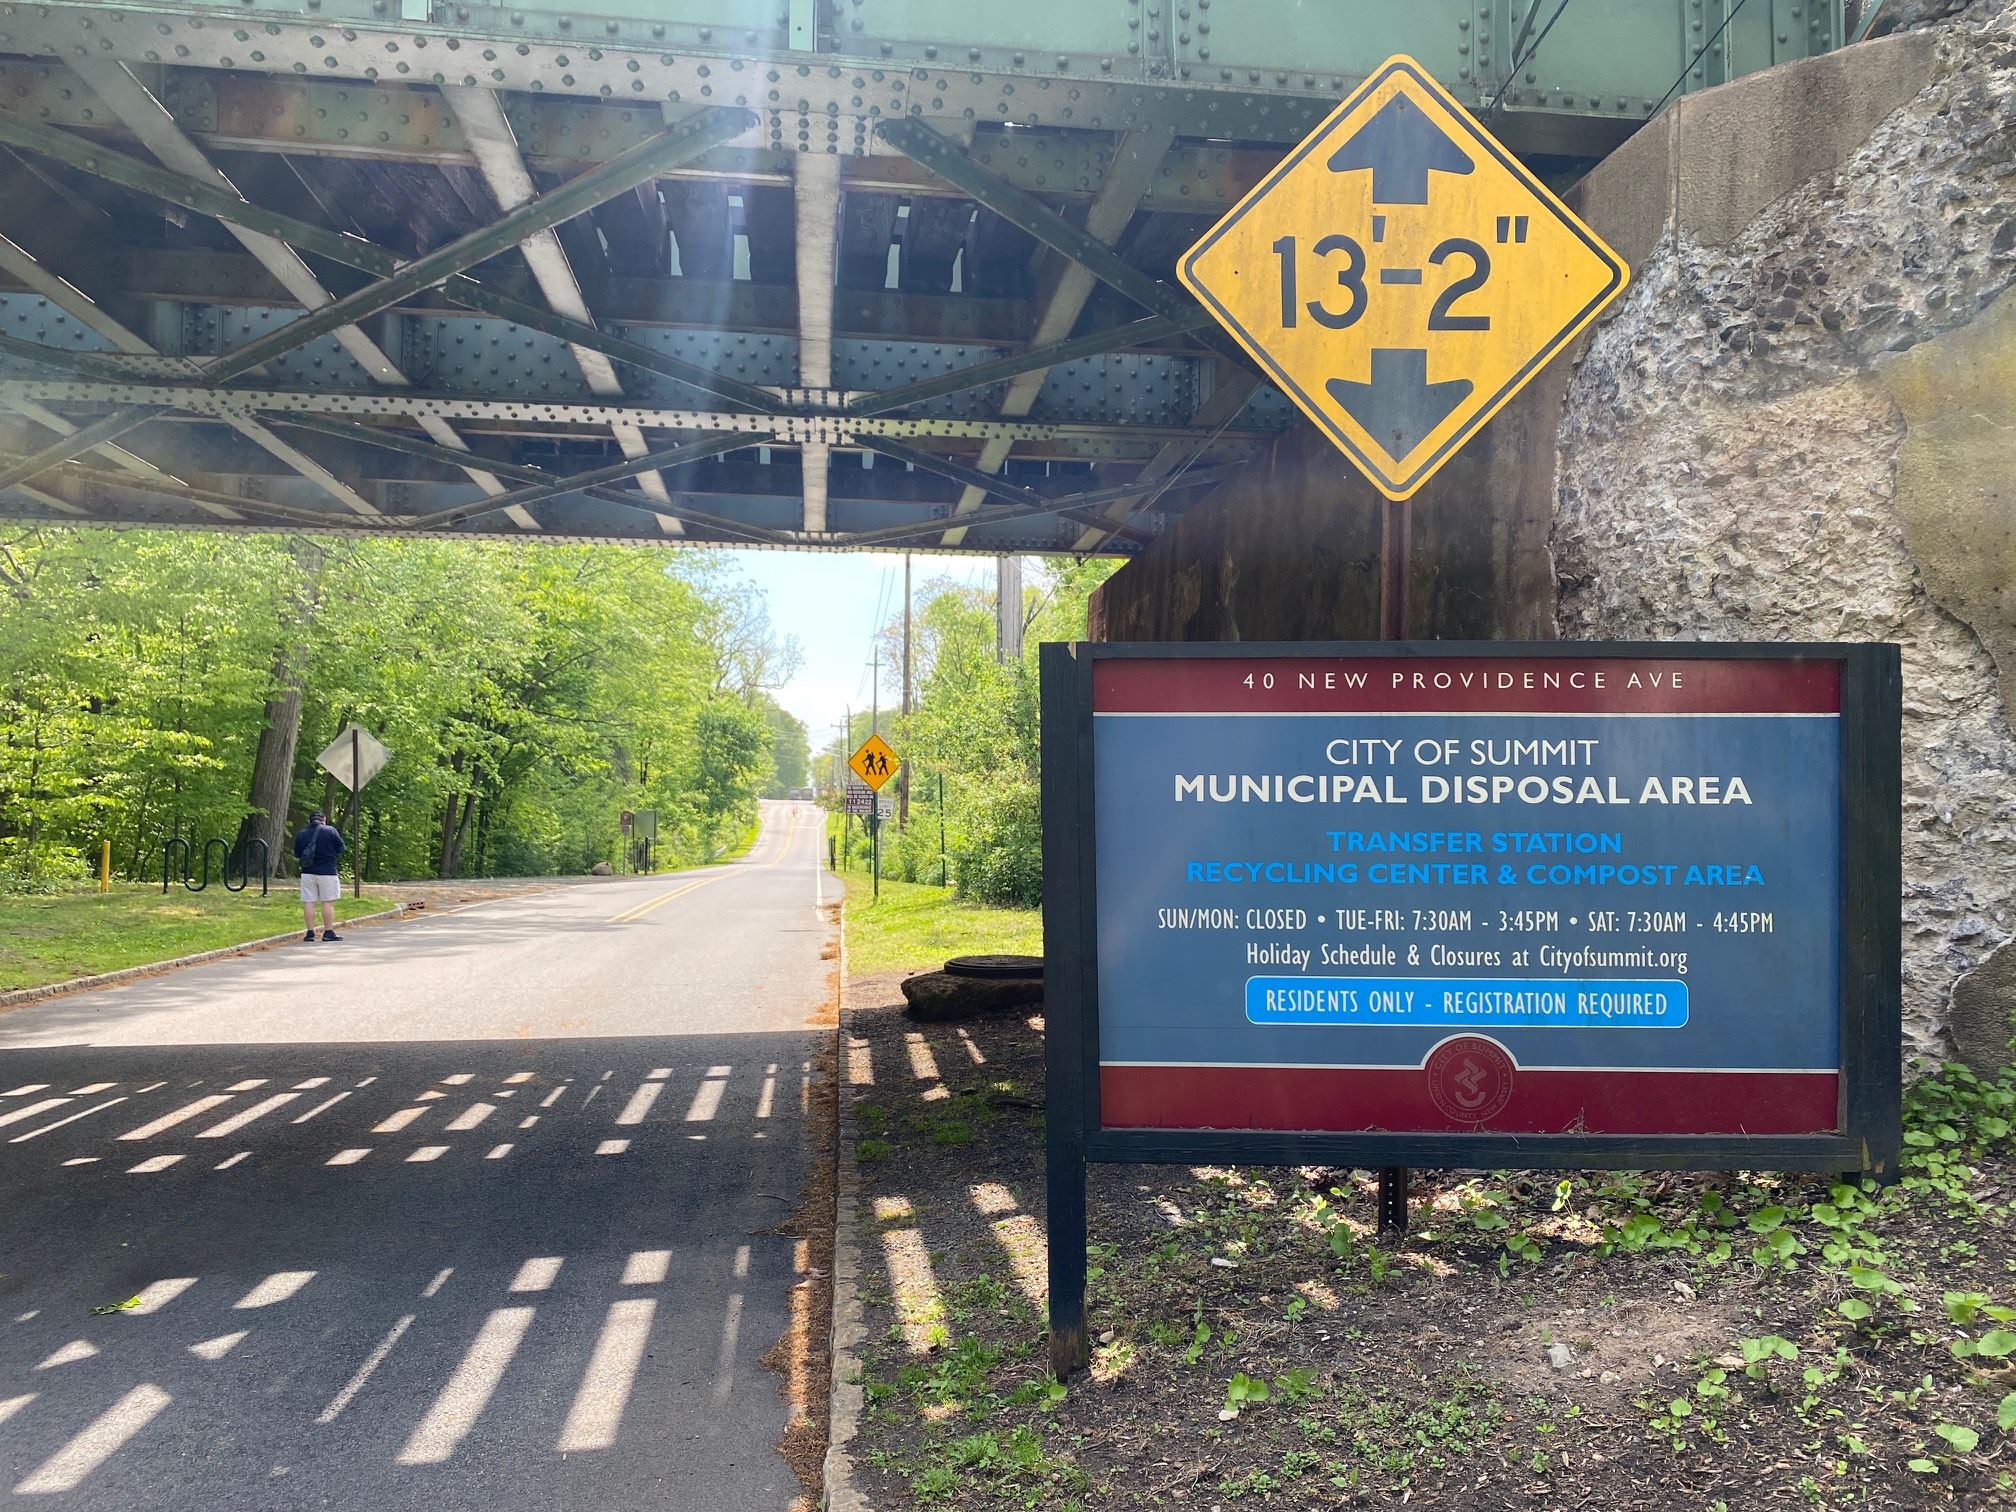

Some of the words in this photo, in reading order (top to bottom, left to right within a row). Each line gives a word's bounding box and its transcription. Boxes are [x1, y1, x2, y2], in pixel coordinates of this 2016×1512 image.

[1272, 215, 1529, 331] 13'-2"
[1243, 672, 1276, 689] 40
[1299, 672, 1369, 689] NEW
[1392, 672, 1606, 689] PROVIDENCE
[1627, 672, 1684, 689] AVE
[1326, 739, 1403, 765] CITY
[1414, 739, 1460, 765] OF
[1470, 739, 1600, 766] SUMMIT
[1174, 774, 1408, 803] MUNICIPAL
[1421, 775, 1631, 804] DISPOSAL
[1638, 776, 1753, 805] AREA
[877, 809, 892, 818] 25
[1326, 831, 1484, 854] TRANSFER
[1490, 831, 1622, 854] STATION
[1186, 860, 1360, 884] RECYCLING
[1366, 862, 1489, 886] CENTER
[1495, 863, 1518, 886] &
[1525, 863, 1679, 886] COMPOST
[1685, 864, 1766, 886] AREA
[1158, 908, 1240, 929] SUN/MON:
[1246, 908, 1307, 930] CLOSED
[1335, 909, 1406, 931] TUE-FRI:
[1412, 909, 1472, 931] 7:30AM
[1498, 910, 1559, 932] 3:45PM
[1588, 911, 1621, 932] SAT:
[1627, 911, 1687, 932] 7:30AM
[1713, 911, 1774, 933] 4:45PM
[1247, 942, 1311, 971] Holiday
[1321, 943, 1397, 966] Schedule
[1407, 944, 1421, 966] &
[1430, 944, 1502, 967] Closures
[1512, 948, 1530, 967] at
[1539, 944, 1688, 975] Cityofsummit.org
[1266, 989, 1359, 1013] RESIDENTS
[1369, 991, 1414, 1013] ONLY
[1443, 991, 1567, 1015] REGISTRATION
[1577, 993, 1668, 1018] REQUIRED
[1434, 1048, 1453, 1069] CITY
[1455, 1042, 1469, 1051] OF
[1472, 1042, 1507, 1069] SUMMIT
